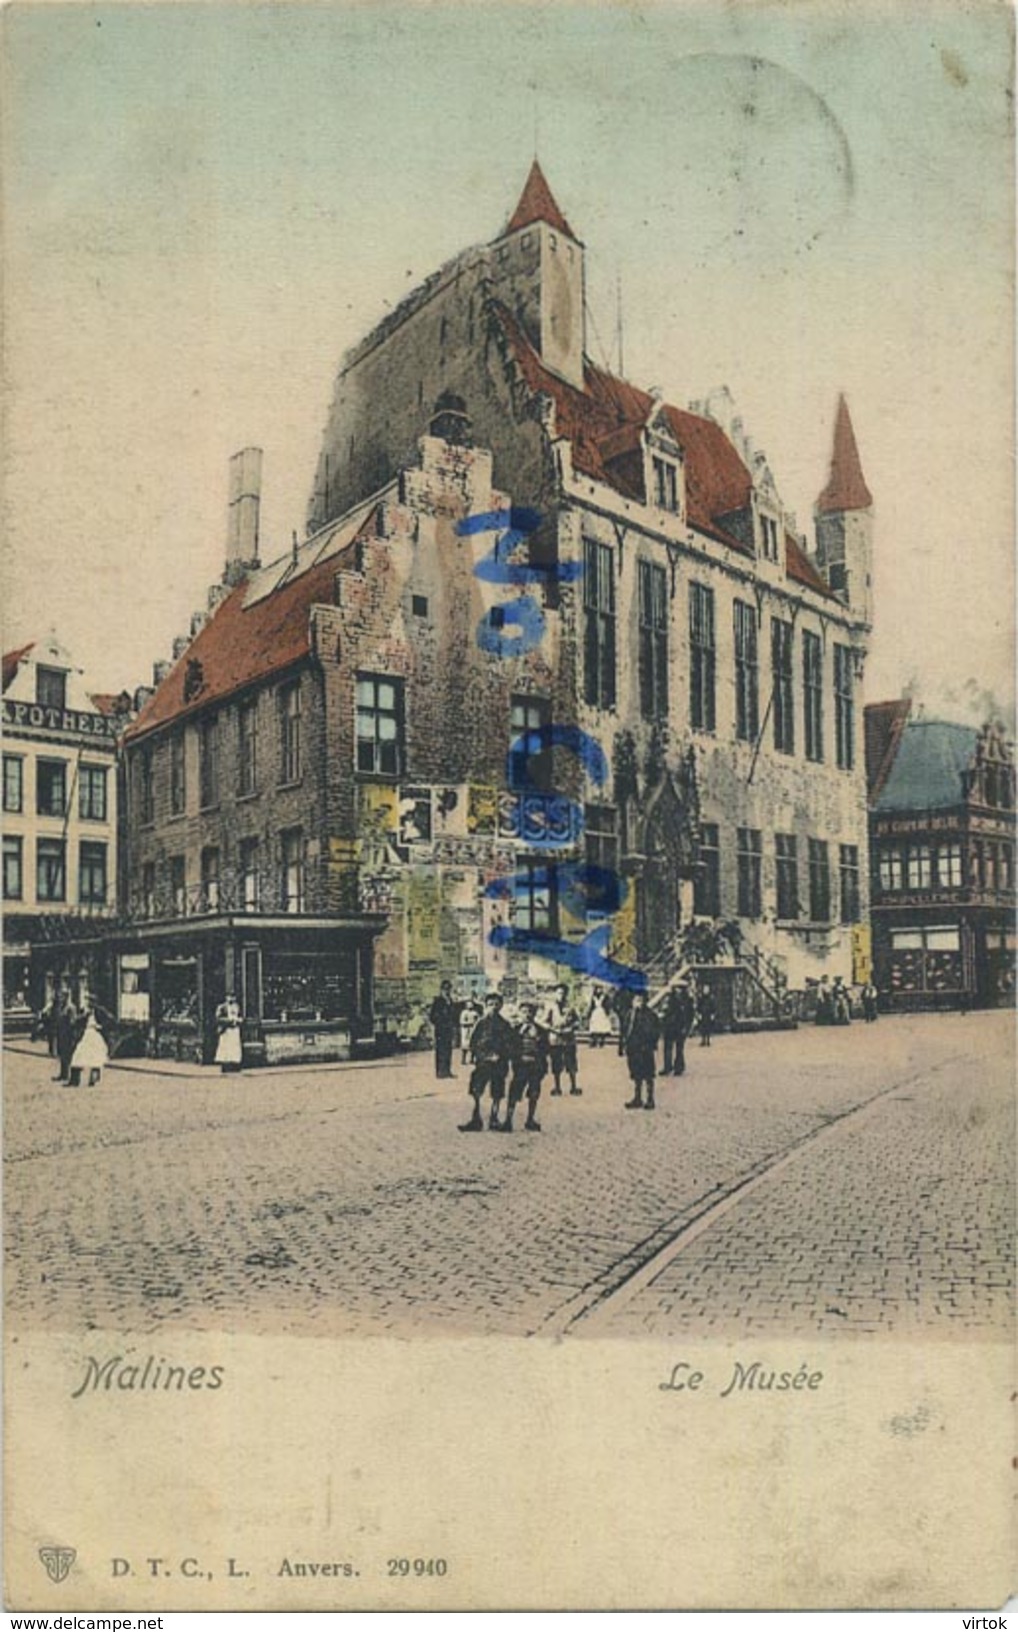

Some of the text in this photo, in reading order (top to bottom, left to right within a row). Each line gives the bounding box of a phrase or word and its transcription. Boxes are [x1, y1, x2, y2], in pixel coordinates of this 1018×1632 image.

[71, 1356, 225, 1399] Malines
[658, 1361, 824, 1398] Le Musée
[111, 1558, 136, 1578] D.
[147, 1558, 171, 1578] T.
[228, 1558, 250, 1578] L.
[277, 1557, 361, 1578] Anvers.
